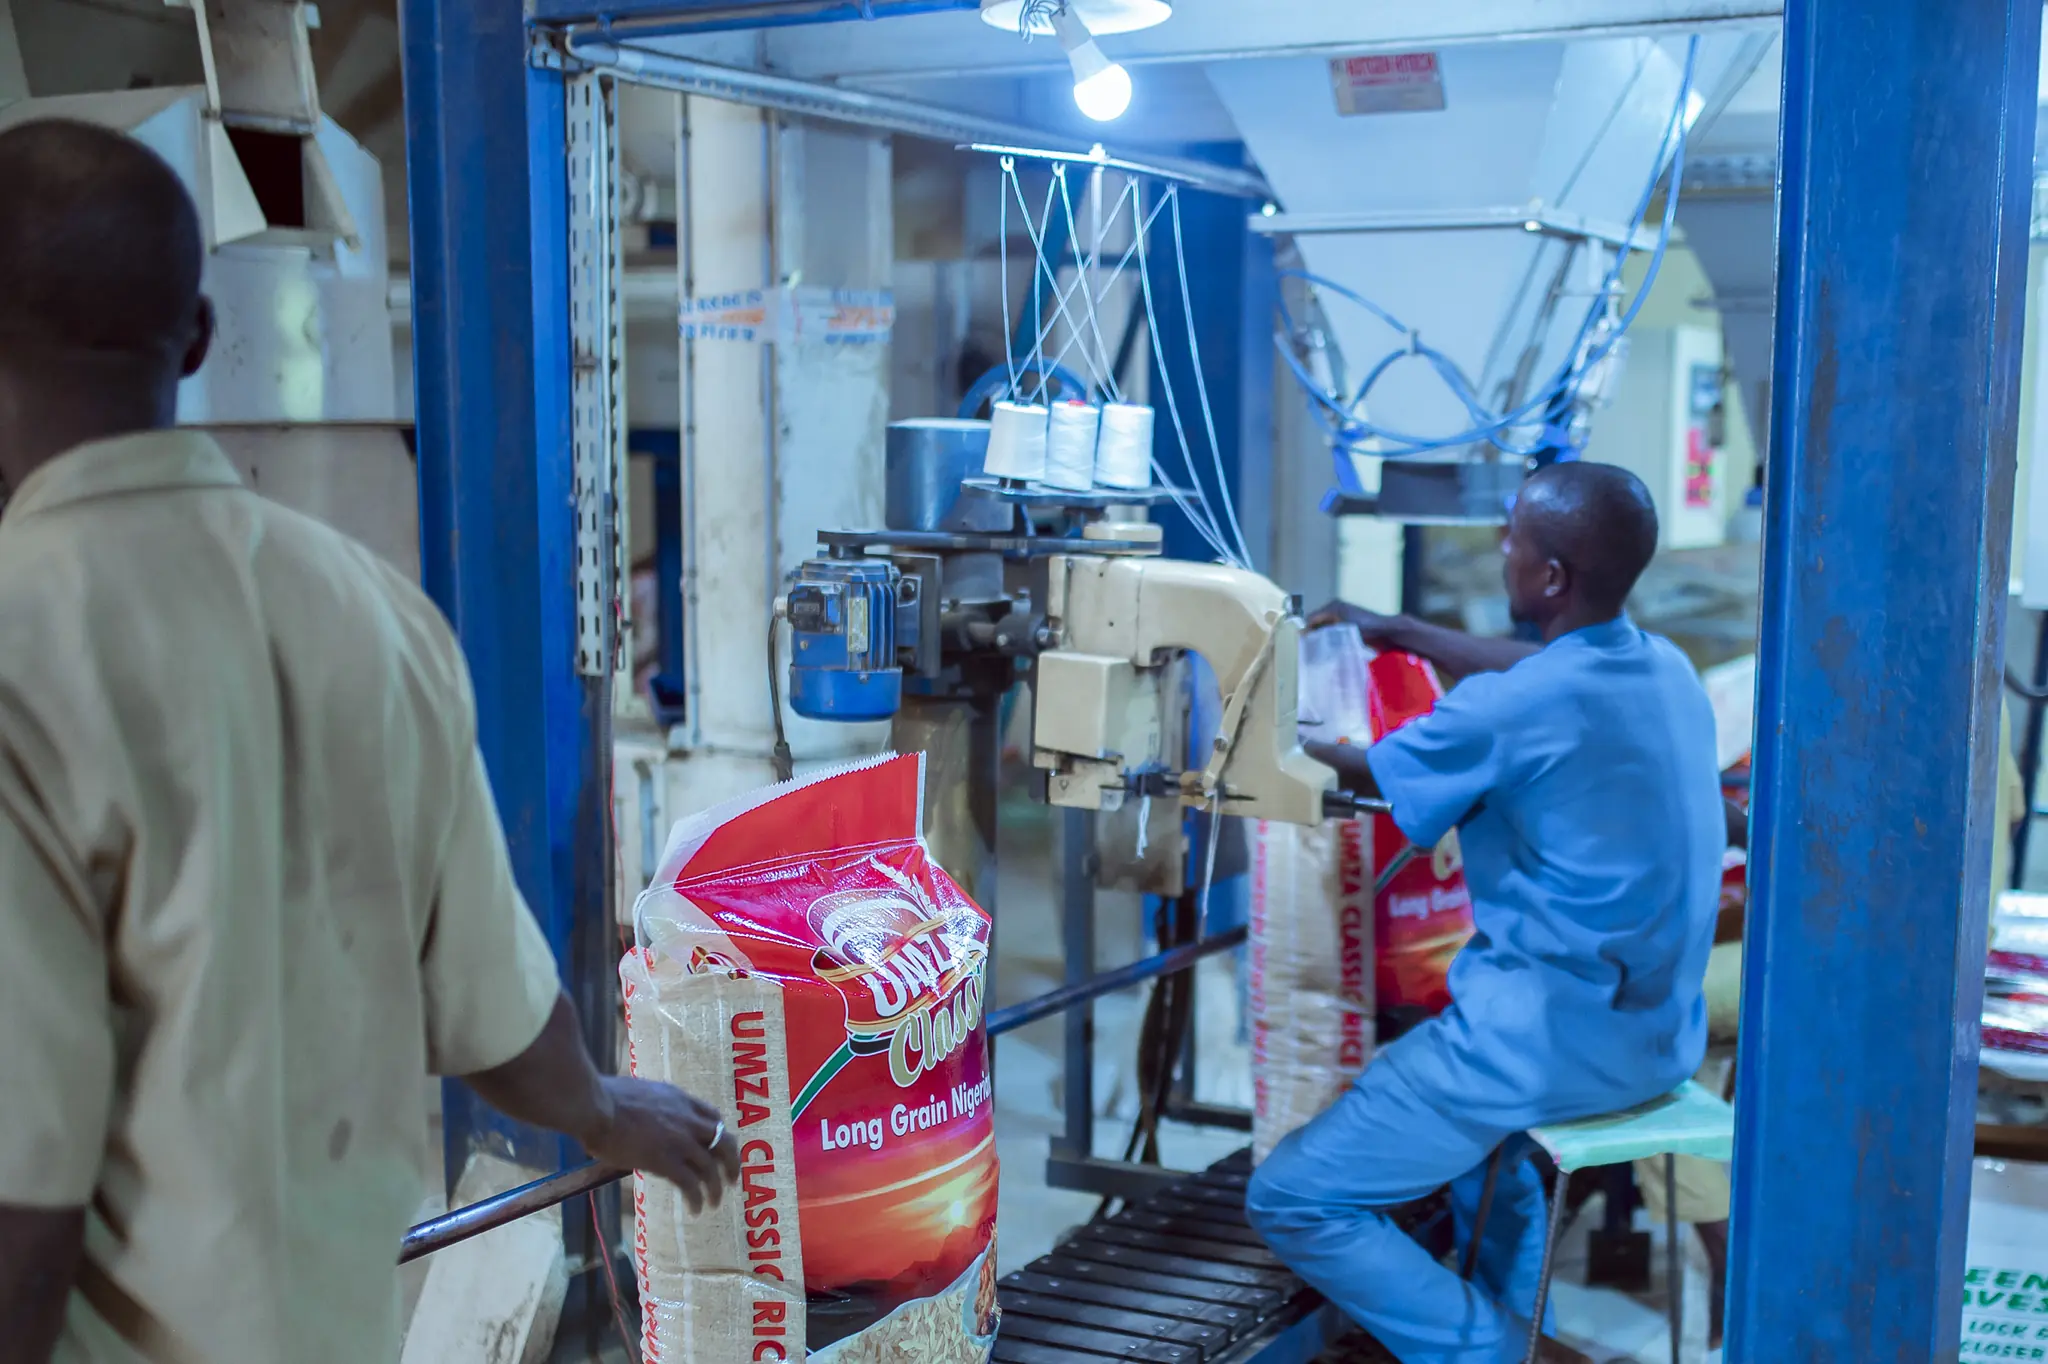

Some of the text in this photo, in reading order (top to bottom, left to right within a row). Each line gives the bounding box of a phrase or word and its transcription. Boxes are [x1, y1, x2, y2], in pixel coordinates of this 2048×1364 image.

[731, 1011, 771, 1128] UMZA
[820, 1118, 884, 1151] Long
[890, 1093, 948, 1137] Grain
